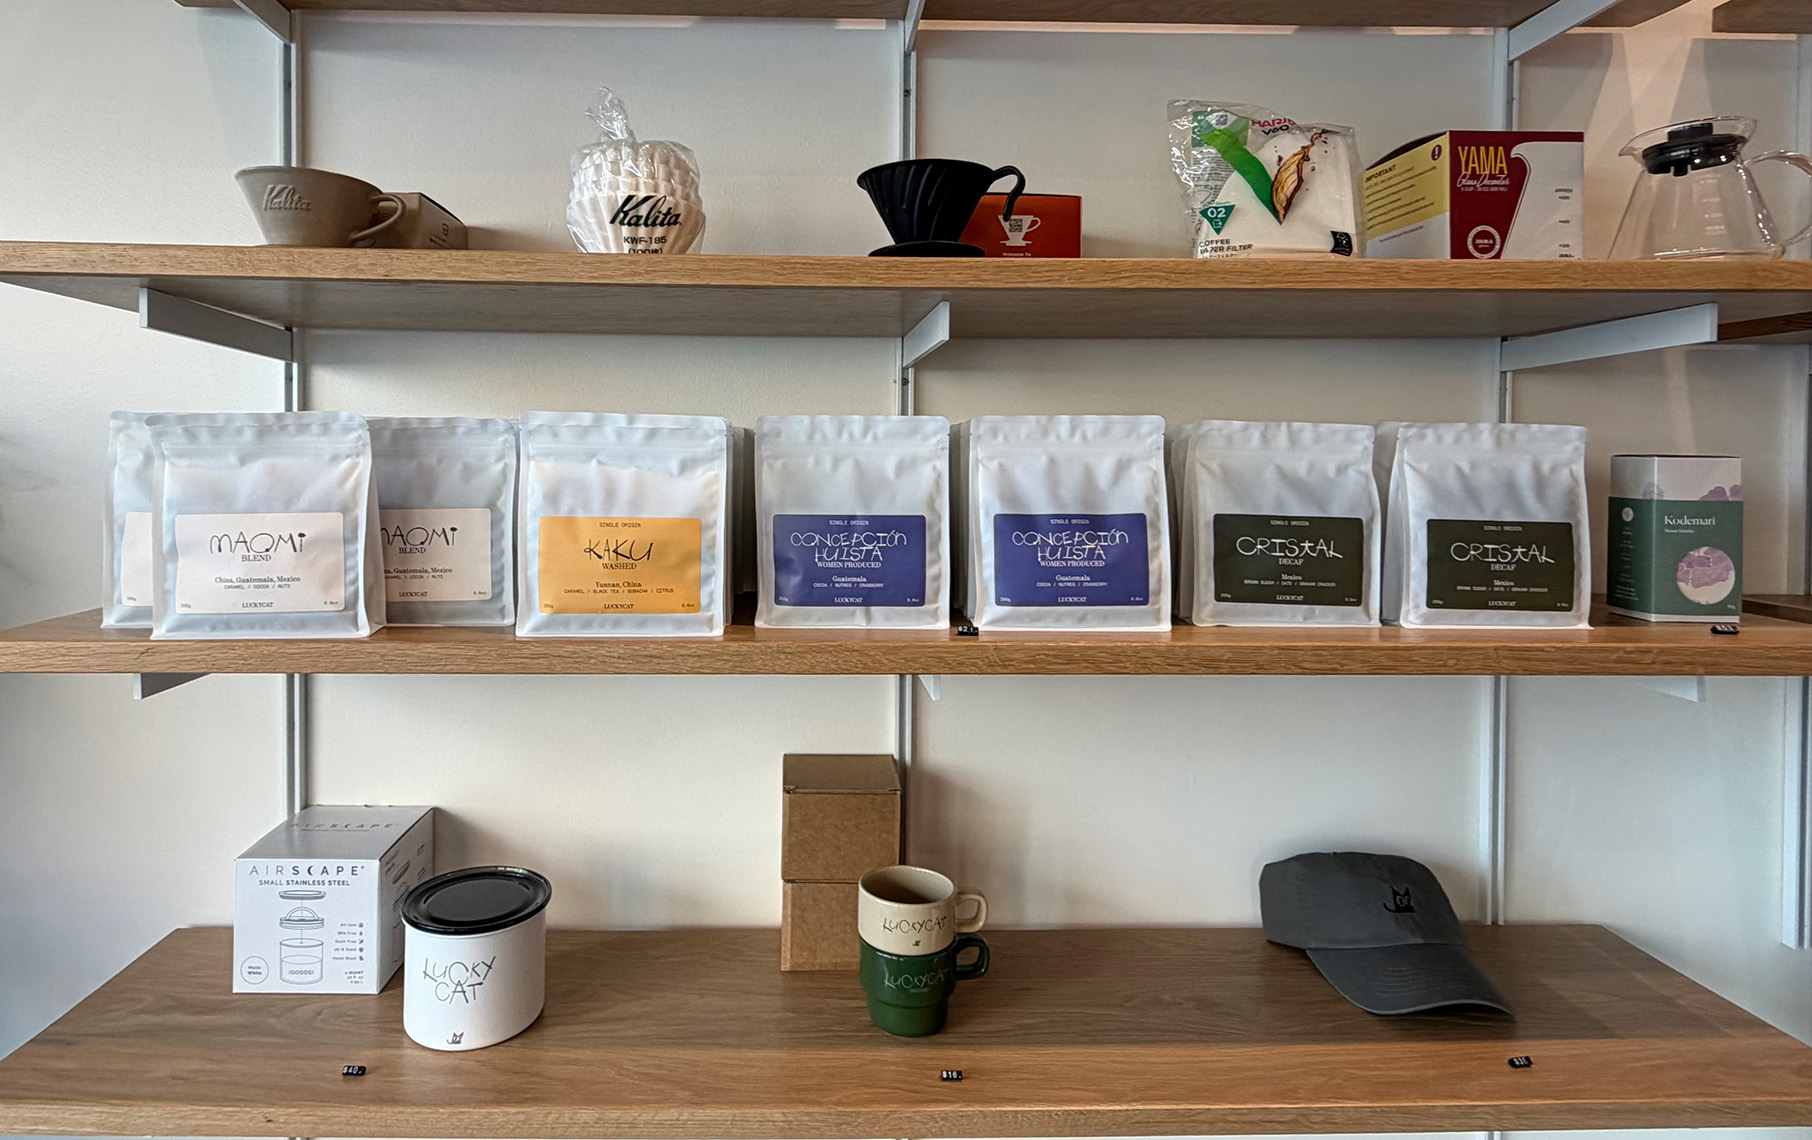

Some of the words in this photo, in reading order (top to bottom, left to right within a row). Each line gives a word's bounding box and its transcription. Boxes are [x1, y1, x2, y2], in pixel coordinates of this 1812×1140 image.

[1457, 146, 1508, 174] YAMA
[262, 184, 311, 211] Kalita
[609, 194, 682, 227] Kalita
[1207, 207, 1227, 218] 02
[623, 235, 667, 244] KWF-185
[1199, 238, 1231, 247] COFFEE
[1226, 243, 1254, 252] FILTER
[1664, 515, 1716, 526] Kodemari
[398, 546, 427, 554] BLEND
[583, 538, 654, 561] KAKU
[1236, 536, 1344, 558] CRISTAL
[241, 554, 272, 562] BLEND
[814, 546, 883, 562] HUISTA
[1037, 545, 1106, 561] HUISTA
[1450, 542, 1556, 564] CRISTAL
[601, 562, 638, 570] WASHED
[1278, 558, 1304, 566] DECAF
[1490, 563, 1517, 571] DECAF
[214, 576, 235, 584] China,
[235, 576, 276, 584] Guatemala,
[276, 575, 301, 583] Mexico
[1281, 573, 1303, 581] Mexico
[422, 956, 496, 985] LUCKY
[435, 980, 484, 1004] CAT
